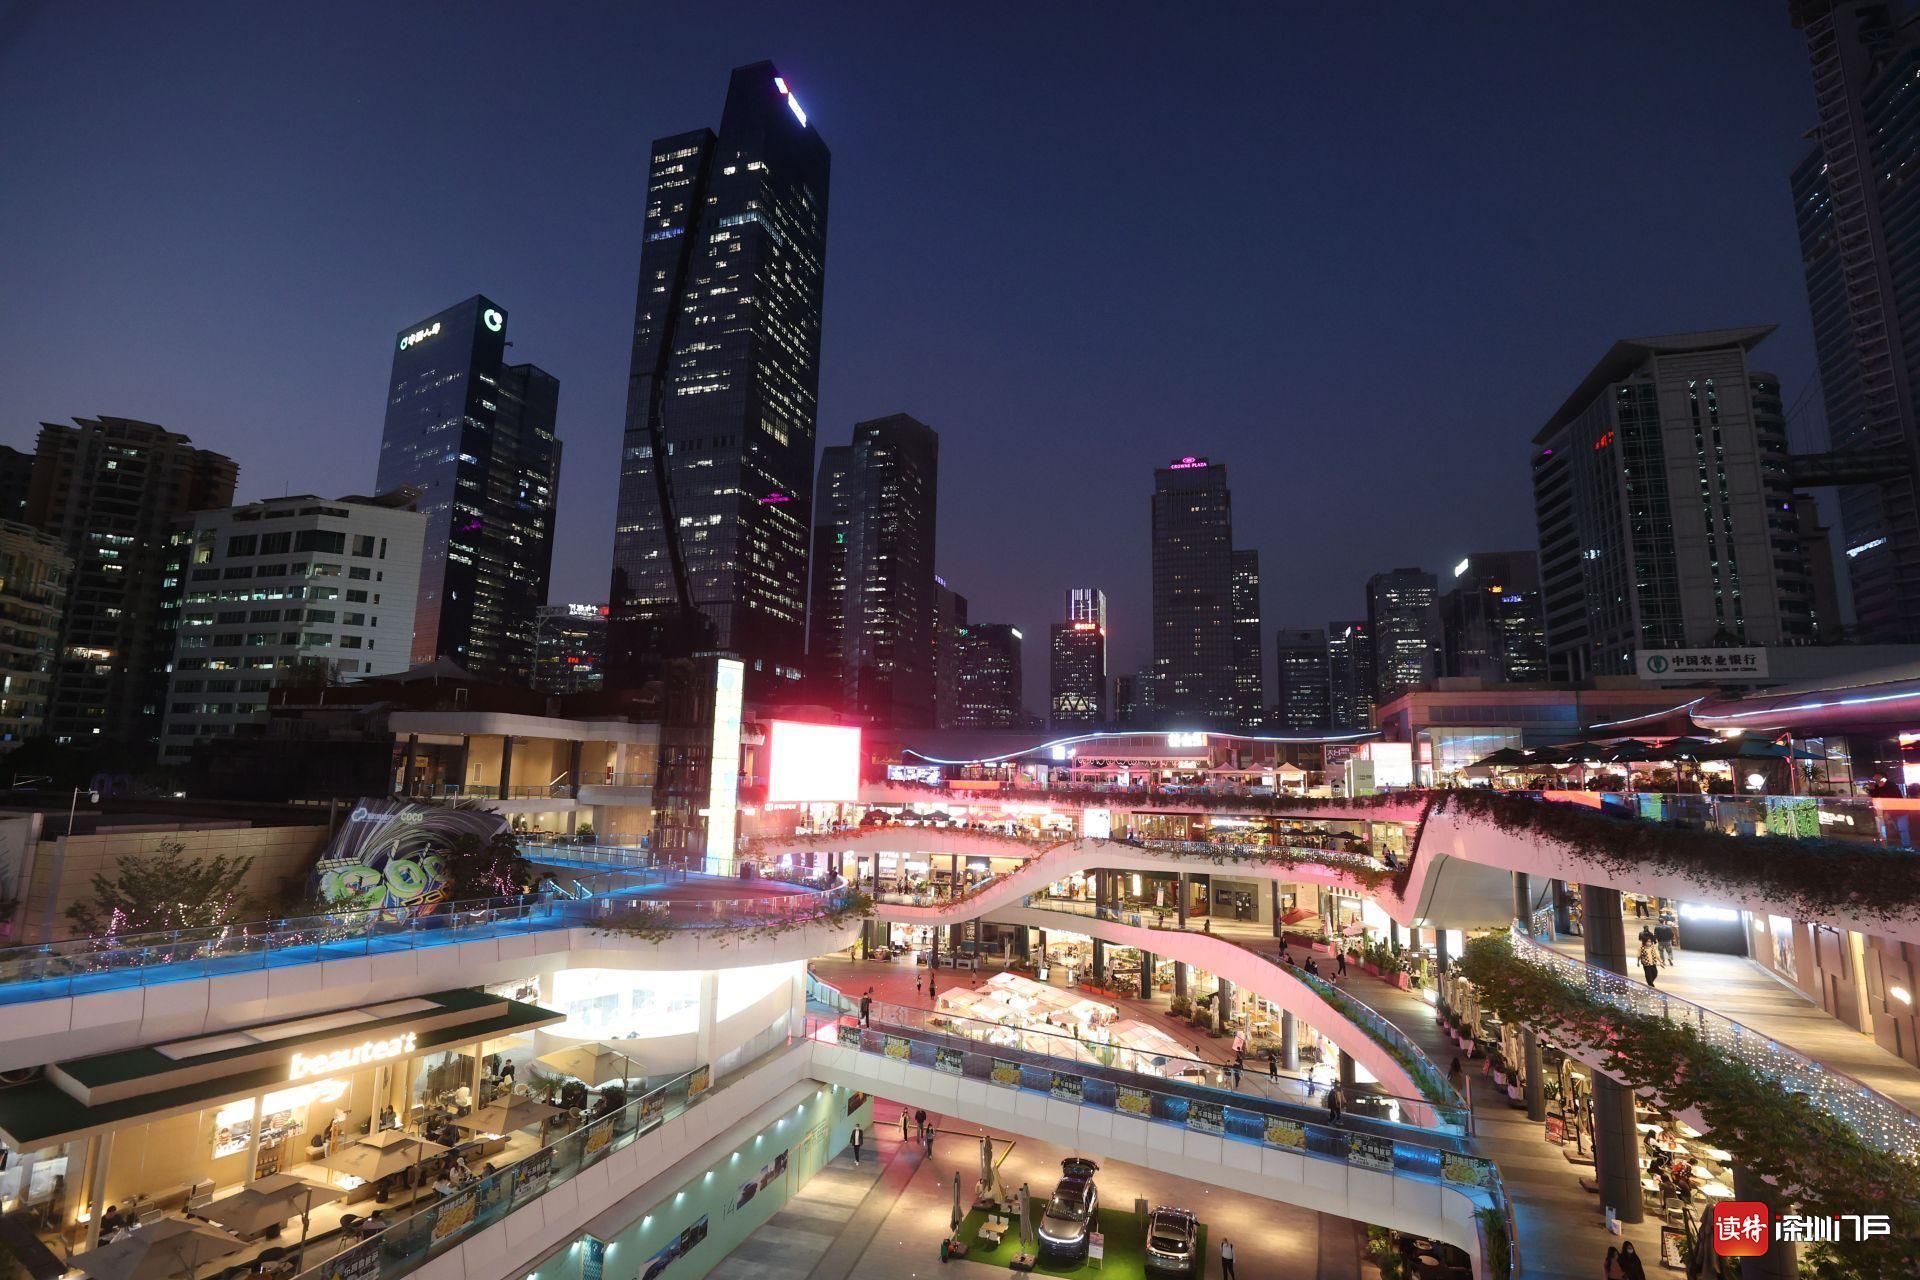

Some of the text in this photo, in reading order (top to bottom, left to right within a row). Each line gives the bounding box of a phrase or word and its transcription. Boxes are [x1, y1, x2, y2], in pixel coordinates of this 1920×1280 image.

[1672, 654, 1756, 666] 中国农业银行
